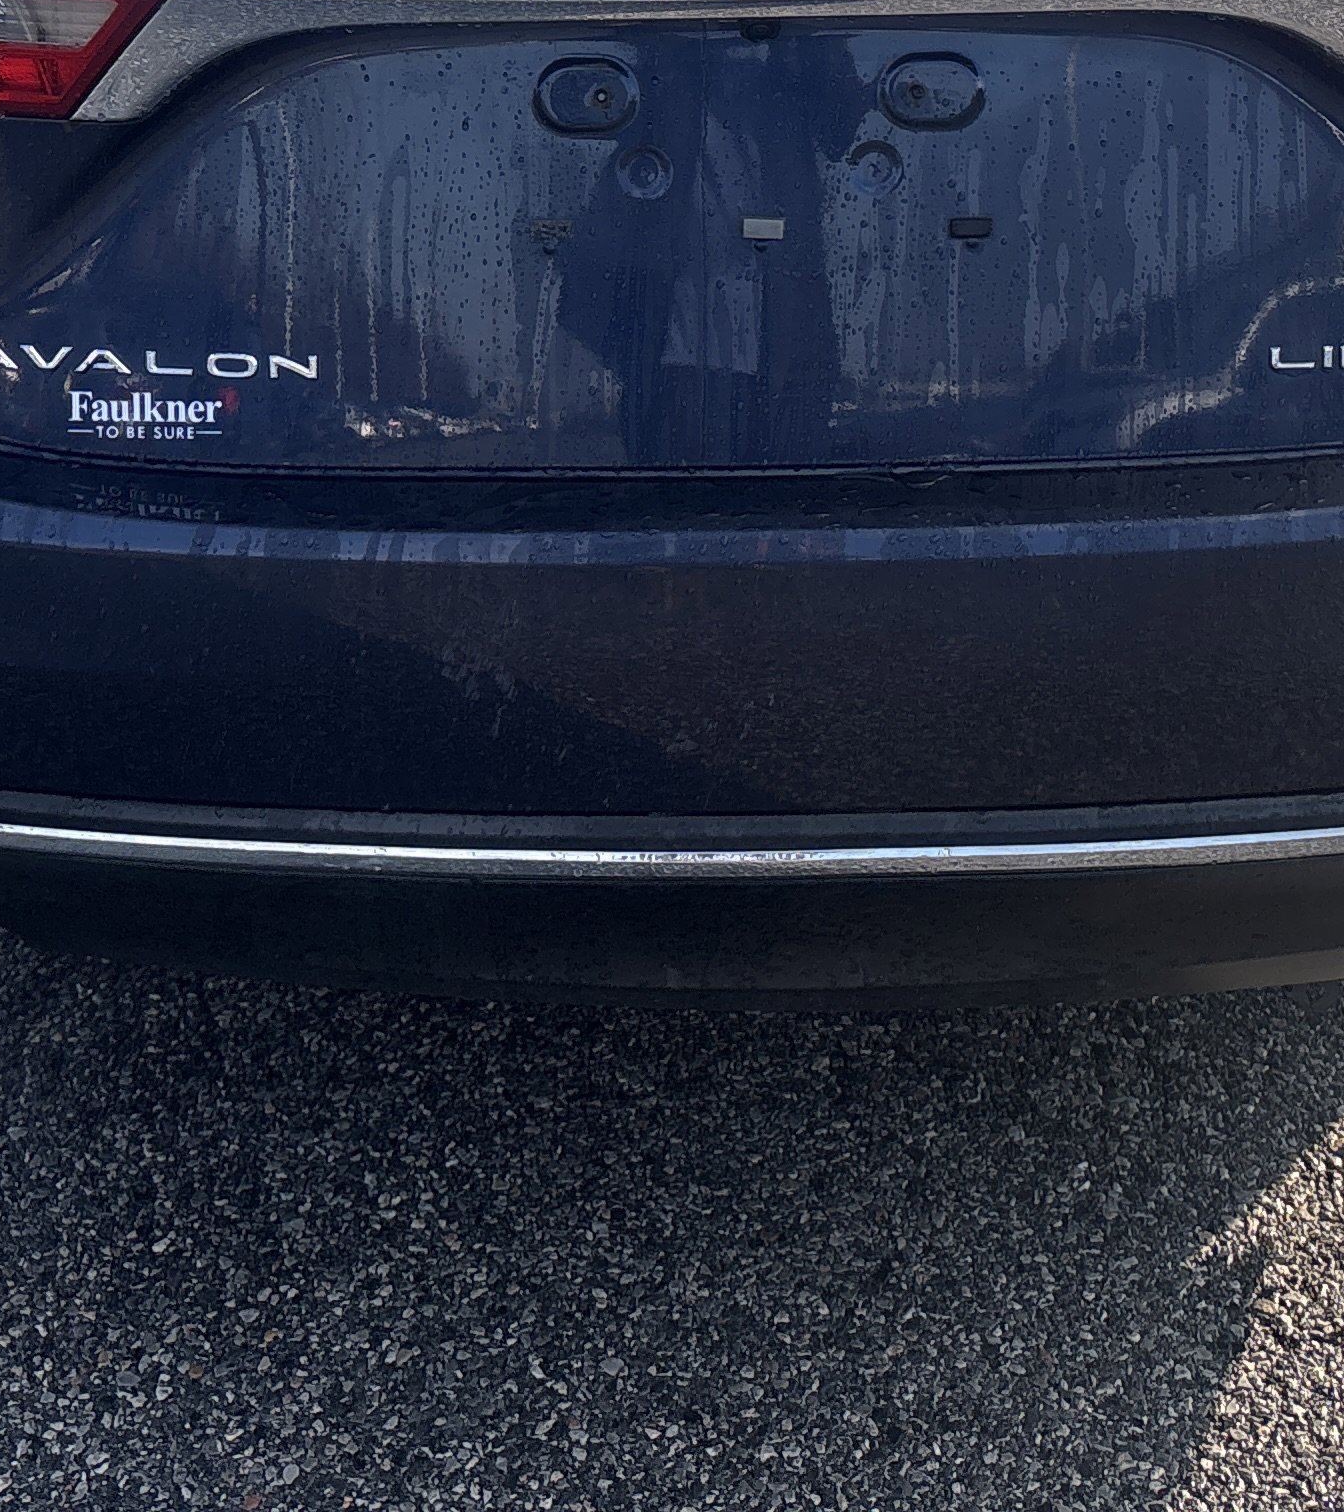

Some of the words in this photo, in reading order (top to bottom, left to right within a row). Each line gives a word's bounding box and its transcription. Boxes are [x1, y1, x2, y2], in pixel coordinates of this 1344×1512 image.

[67, 390, 223, 424] Faulkner
[95, 426, 120, 439] TO
[126, 426, 146, 439] BE
[153, 426, 196, 440] SURE
